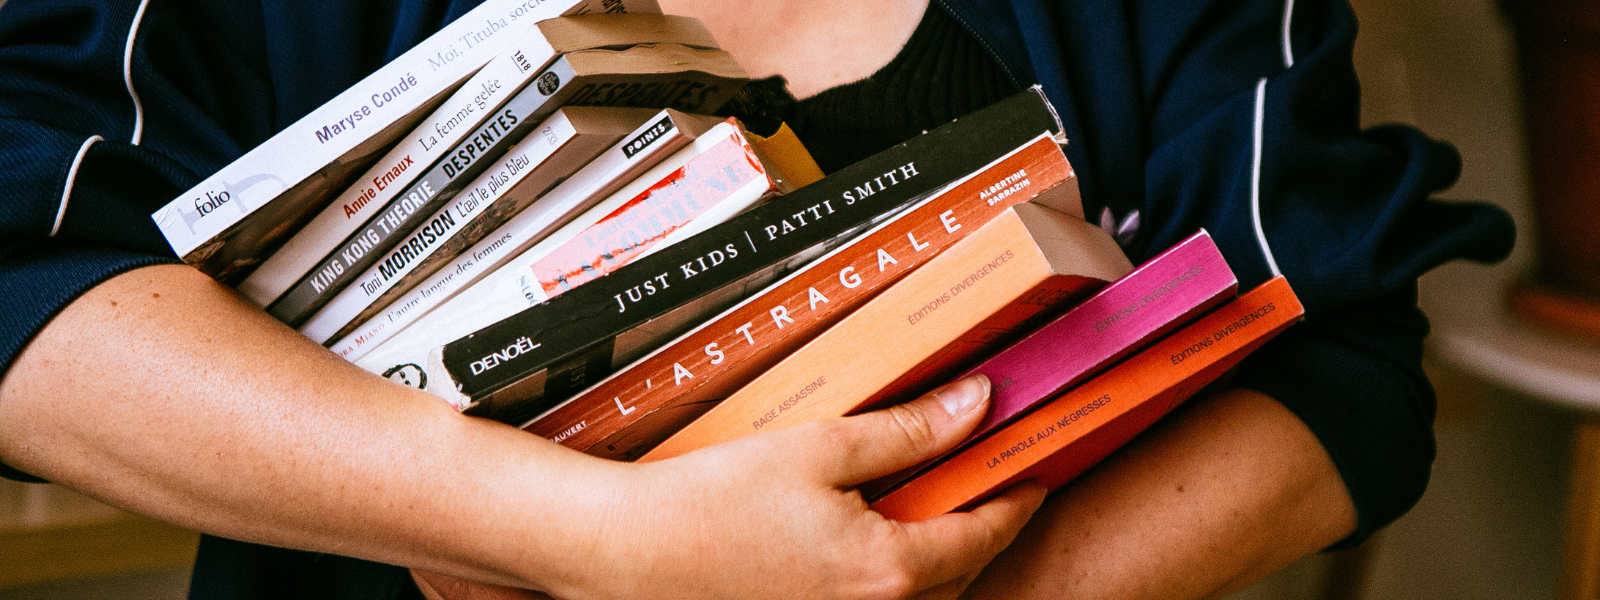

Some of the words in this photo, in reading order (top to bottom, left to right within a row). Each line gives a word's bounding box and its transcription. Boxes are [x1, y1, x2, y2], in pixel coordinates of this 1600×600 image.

[427, 44, 463, 72] Moi,
[458, 17, 508, 51] Tituba
[509, 0, 547, 21] sorci
[514, 50, 531, 71] 1818
[315, 102, 371, 145] Maryse
[370, 72, 417, 109] Condé
[418, 133, 438, 153] La
[431, 101, 475, 142] femme
[473, 77, 502, 110] gelée
[627, 123, 666, 155] POINTS
[194, 187, 230, 218] folio
[310, 260, 344, 294] KING
[342, 229, 380, 266] KONG
[442, 108, 519, 178] DESPENTES
[342, 187, 376, 220] Annie
[373, 154, 415, 192] Ernaux
[979, 169, 1027, 200] ALBERTINE
[987, 178, 1030, 206] SARRAZIN
[359, 274, 382, 298] Toni
[378, 209, 456, 281] MORRISON
[476, 187, 489, 201] le
[488, 168, 510, 196] plus
[507, 152, 530, 183] bleu
[613, 273, 671, 313] JUST
[680, 243, 739, 280] KIDS
[764, 200, 835, 241] PATTI
[843, 162, 920, 206] SMITH
[419, 268, 455, 303] langue
[455, 253, 474, 277] des
[472, 231, 513, 264] femmes
[1094, 302, 1139, 333] ÉDITIONS
[1138, 264, 1204, 308] DIVERGENCES
[614, 209, 962, 416] L'ASTRAGALE
[752, 406, 779, 431] RAGE
[776, 375, 828, 411] ASSASSINE
[907, 292, 951, 326] ÉDITIONS
[949, 249, 1015, 298] DIVERGENCES
[469, 336, 542, 376] DENOËL
[986, 455, 1002, 470] LA
[1000, 435, 1036, 461] PAROLE
[1035, 424, 1058, 443] AUX
[1056, 393, 1112, 428] NÉGRESSES
[1170, 331, 1214, 366] ÉDITIONS
[1212, 301, 1276, 343] DIVERGENCES
